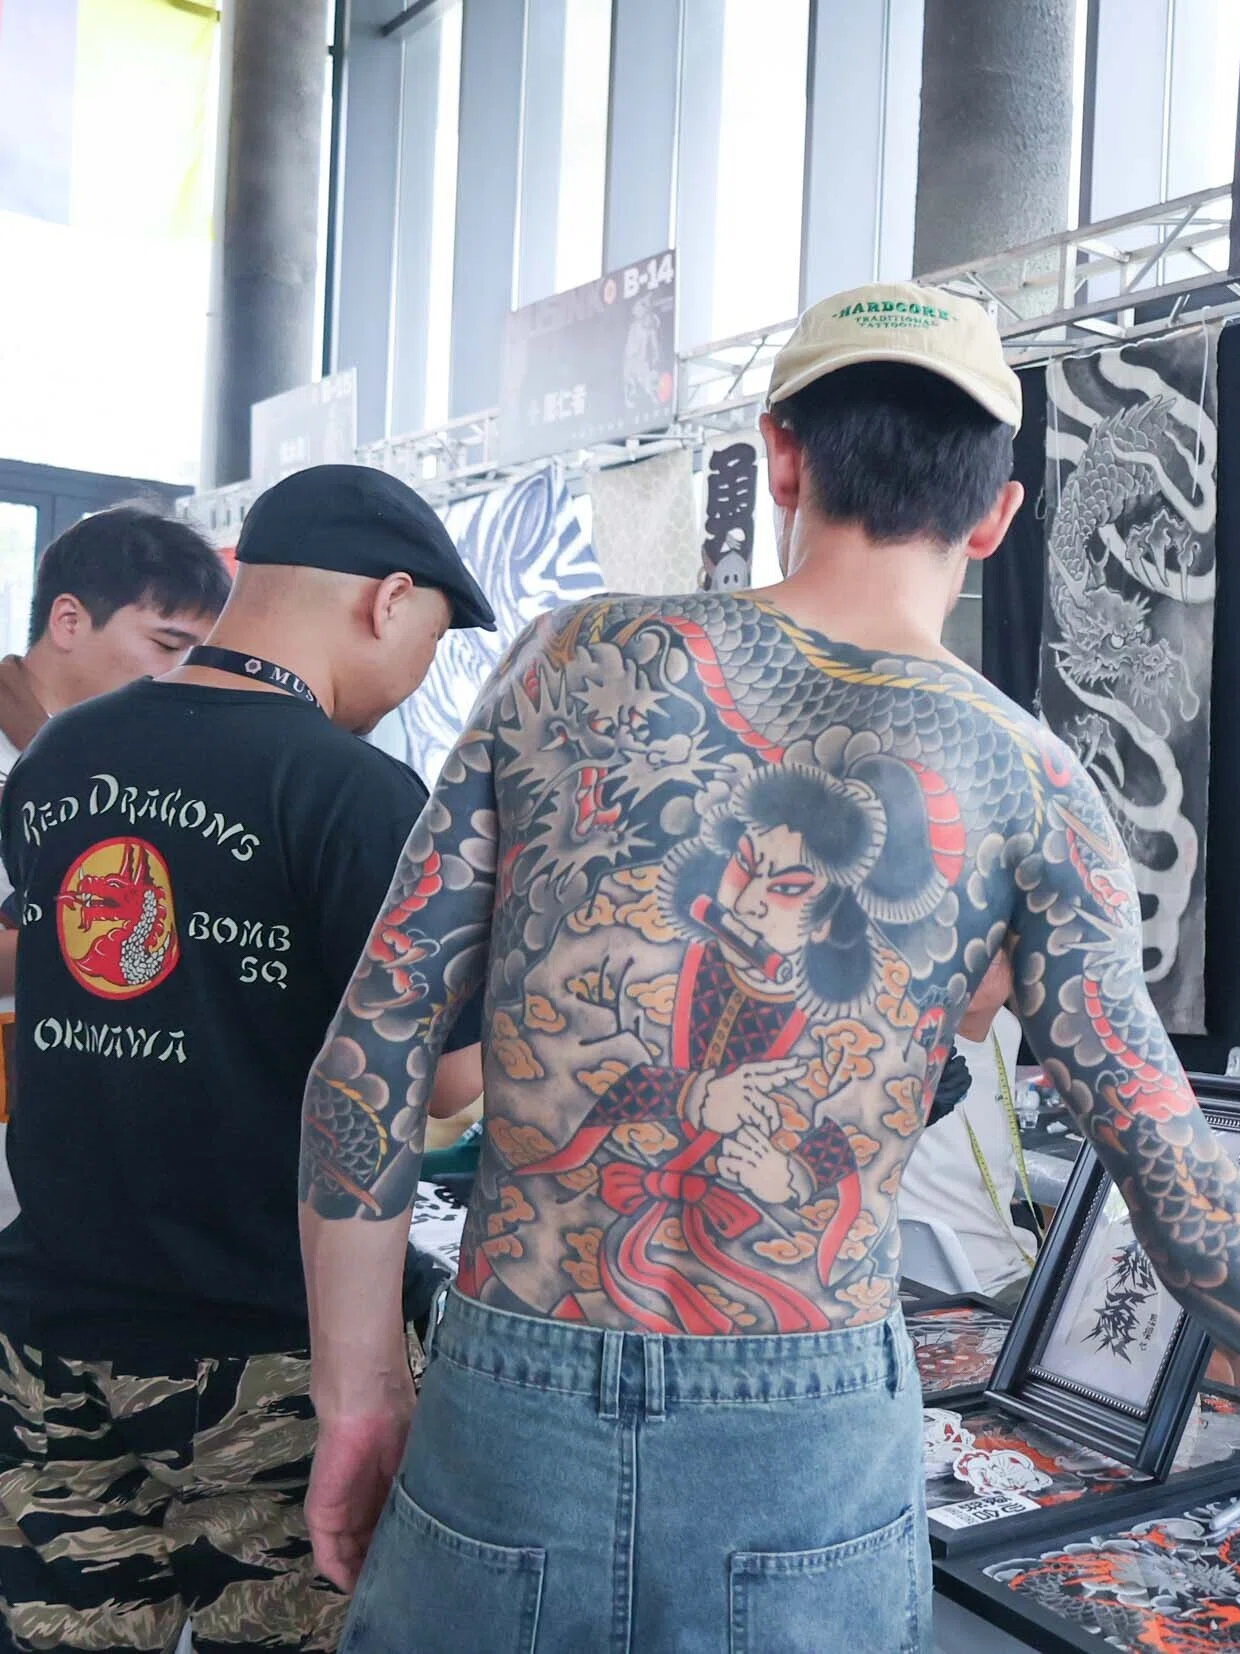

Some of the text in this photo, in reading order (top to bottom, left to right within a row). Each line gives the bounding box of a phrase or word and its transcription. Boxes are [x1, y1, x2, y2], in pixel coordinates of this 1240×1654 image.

[623, 253, 674, 299] B-14
[22, 773, 260, 861] RED DRAGONS
[189, 911, 291, 951] BOMB
[239, 956, 288, 989] SQ
[34, 1017, 187, 1064] OKINAWA
